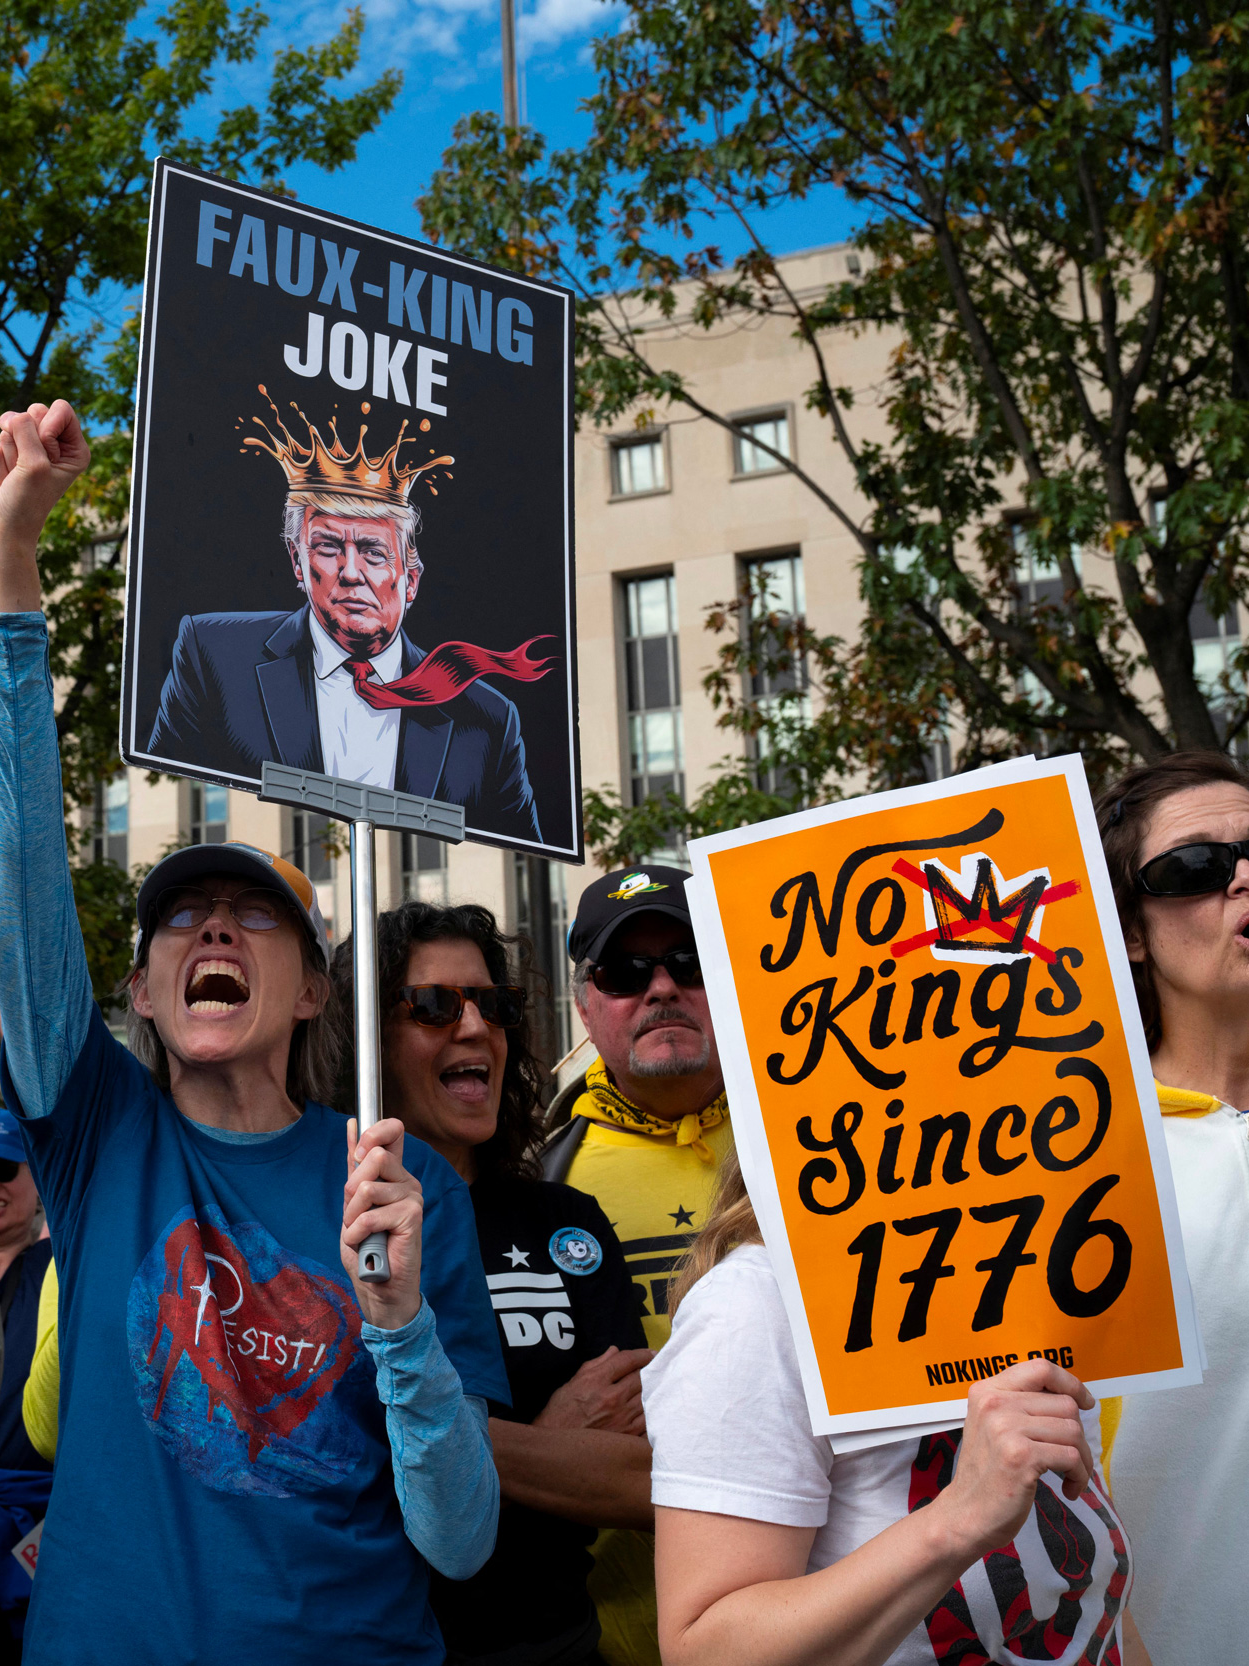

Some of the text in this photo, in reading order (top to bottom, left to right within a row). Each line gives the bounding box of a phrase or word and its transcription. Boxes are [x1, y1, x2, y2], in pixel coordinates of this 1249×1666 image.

[196, 199, 534, 366] FAUX-KING
[283, 312, 450, 417] JOKE
[759, 807, 1005, 973] No
[766, 947, 1105, 1091] Kings
[796, 1056, 1112, 1216] Since
[499, 1311, 575, 1350] DC
[843, 1174, 1133, 1353] 1776
